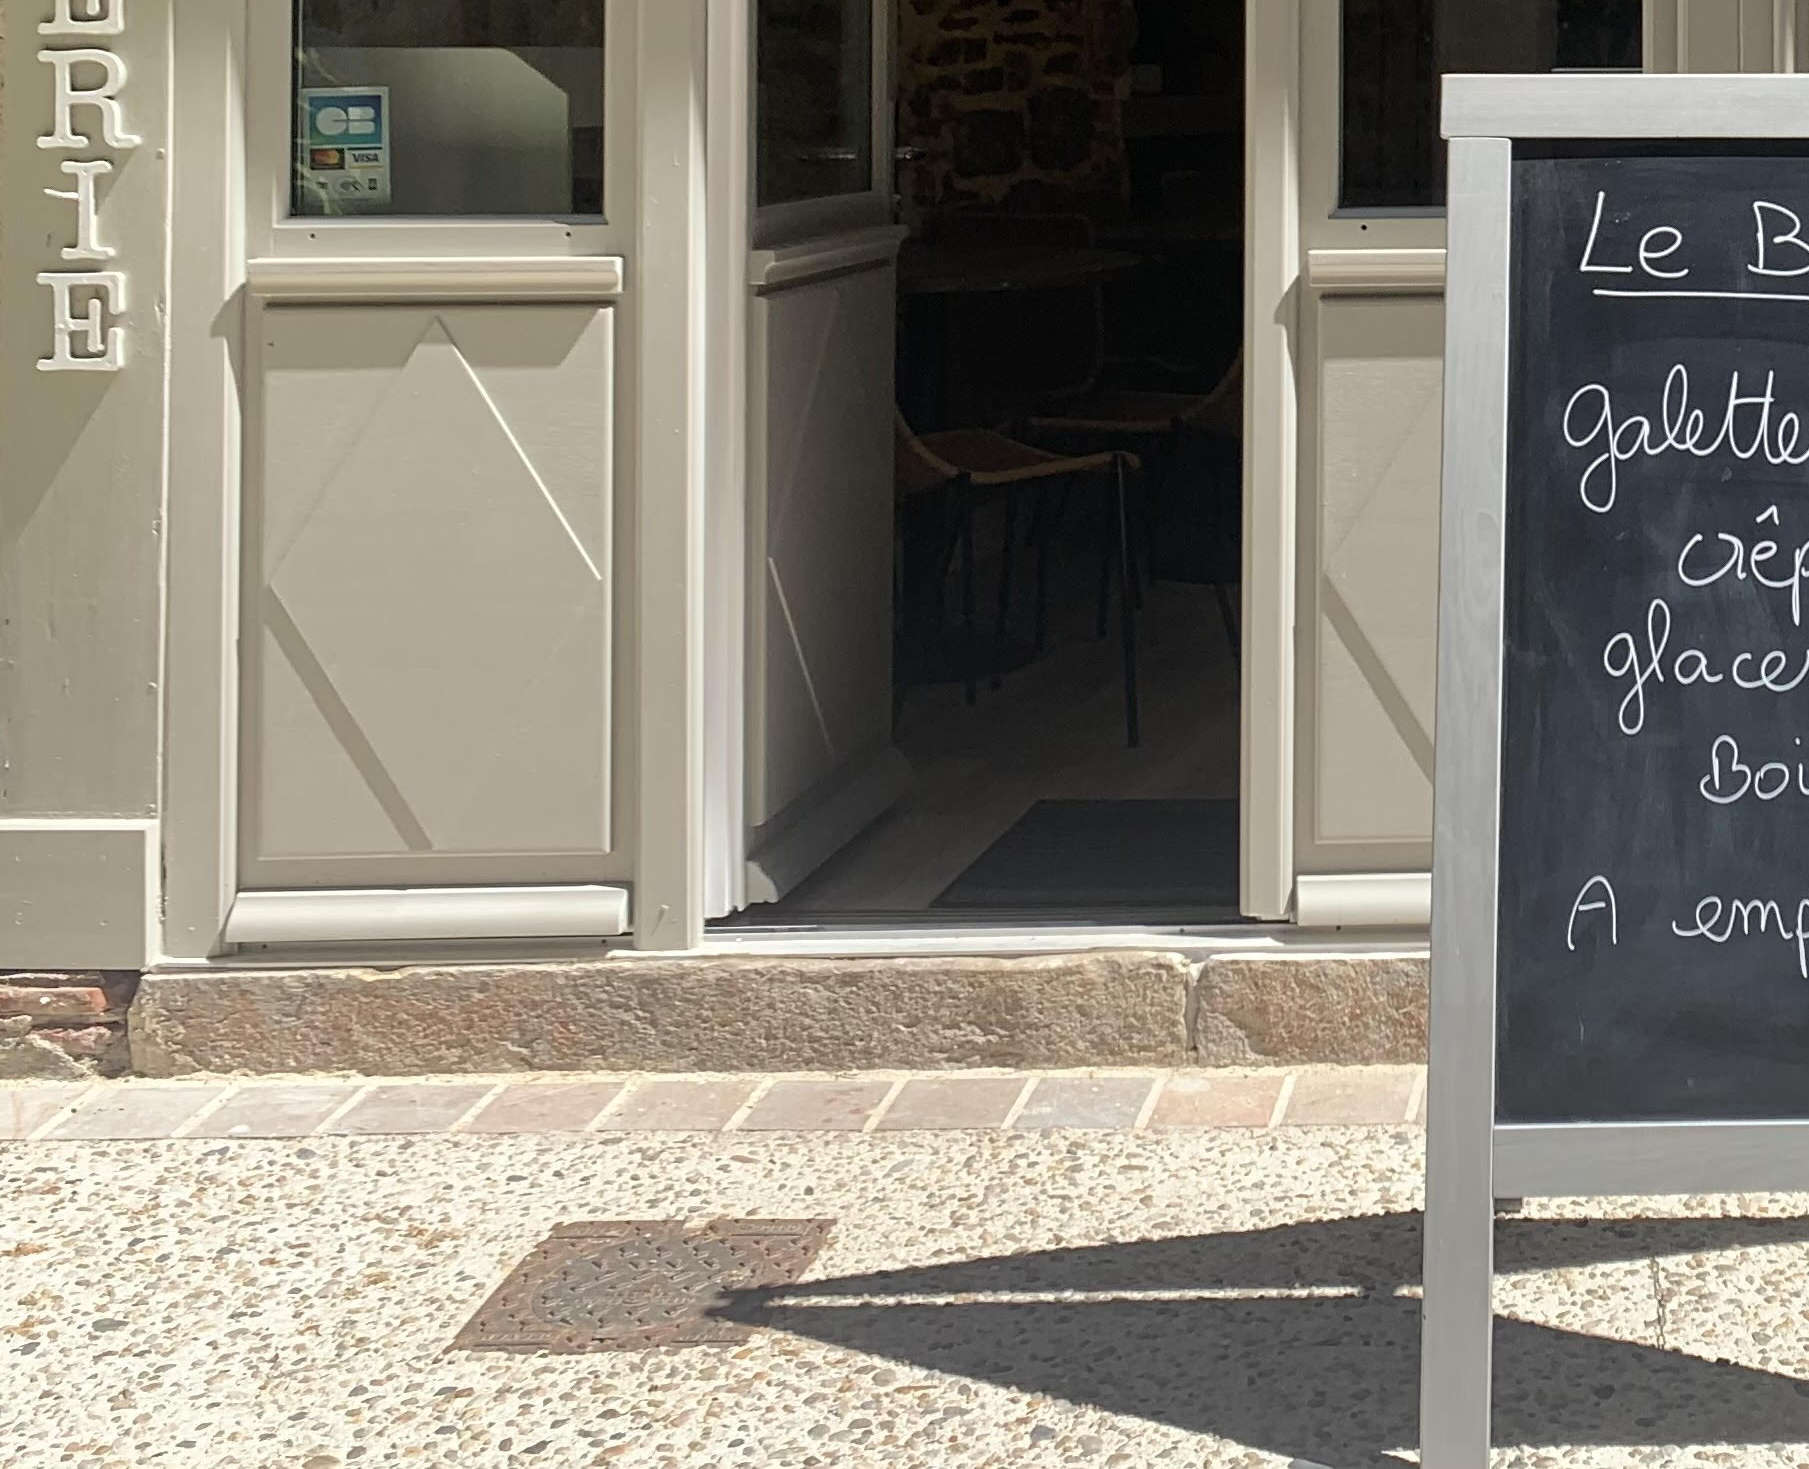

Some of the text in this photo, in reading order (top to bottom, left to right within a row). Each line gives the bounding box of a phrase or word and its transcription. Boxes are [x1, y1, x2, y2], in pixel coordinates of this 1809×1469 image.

[351, 153, 379, 163] VISA
[1580, 191, 1688, 277] Le
[1567, 875, 1617, 950] A
